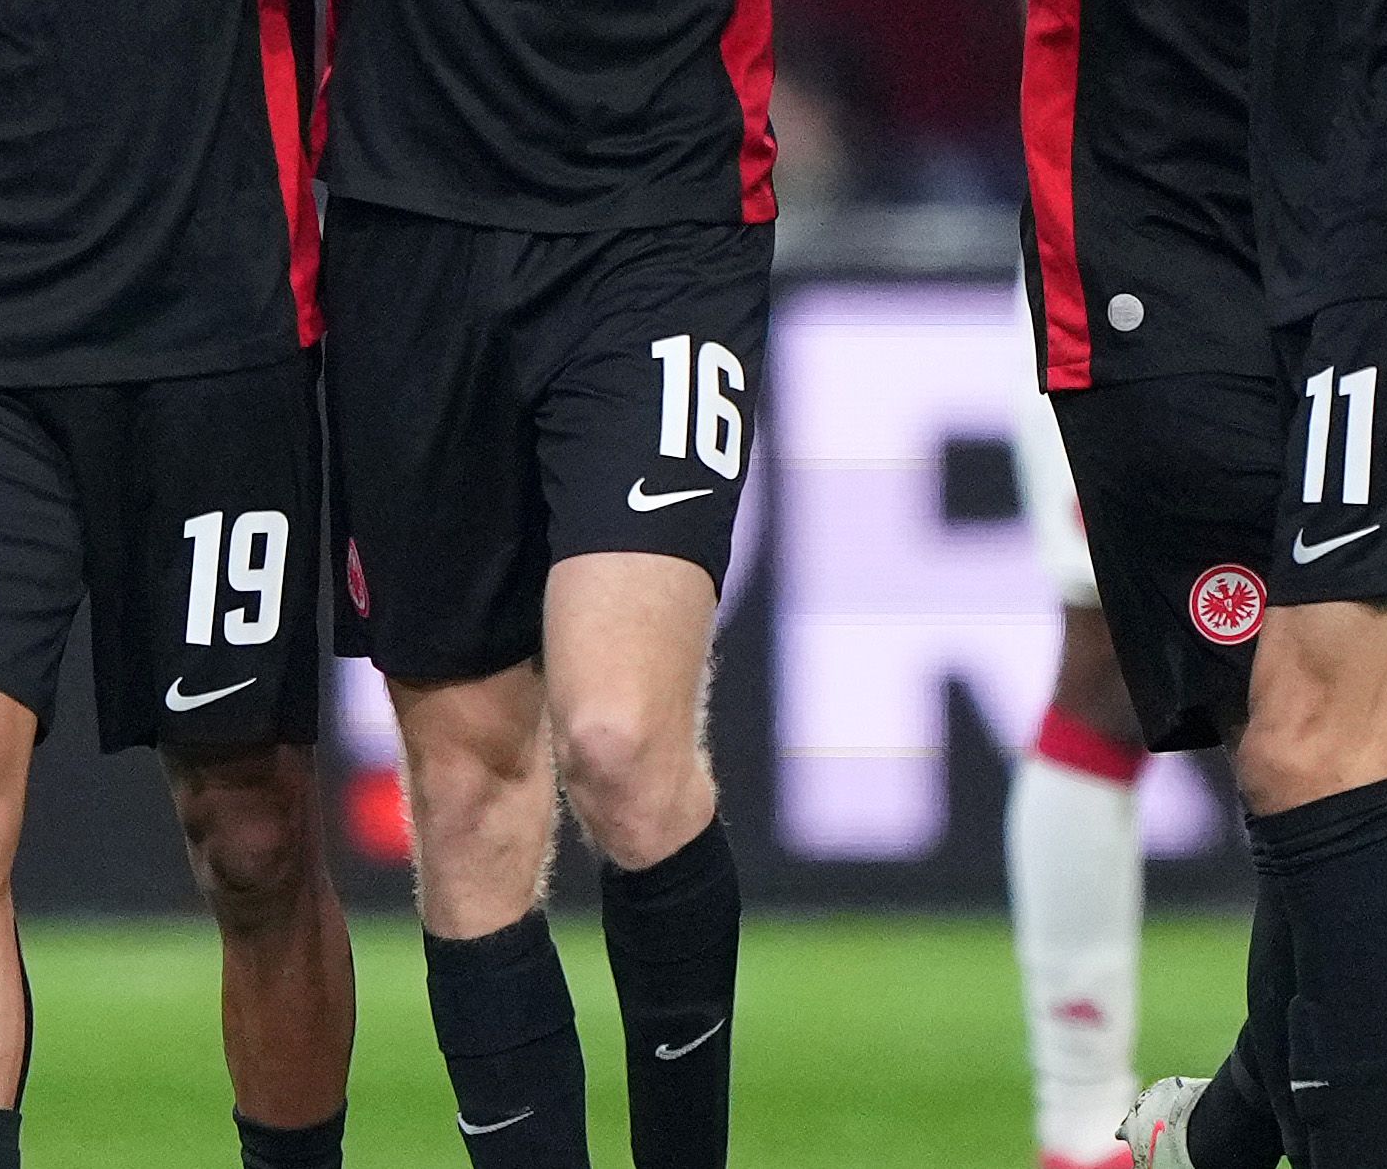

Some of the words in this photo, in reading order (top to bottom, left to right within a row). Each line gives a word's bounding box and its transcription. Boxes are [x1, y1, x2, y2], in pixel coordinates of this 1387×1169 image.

[651, 334, 746, 480] 16
[1302, 365, 1378, 504] 11
[183, 510, 289, 646] 19
